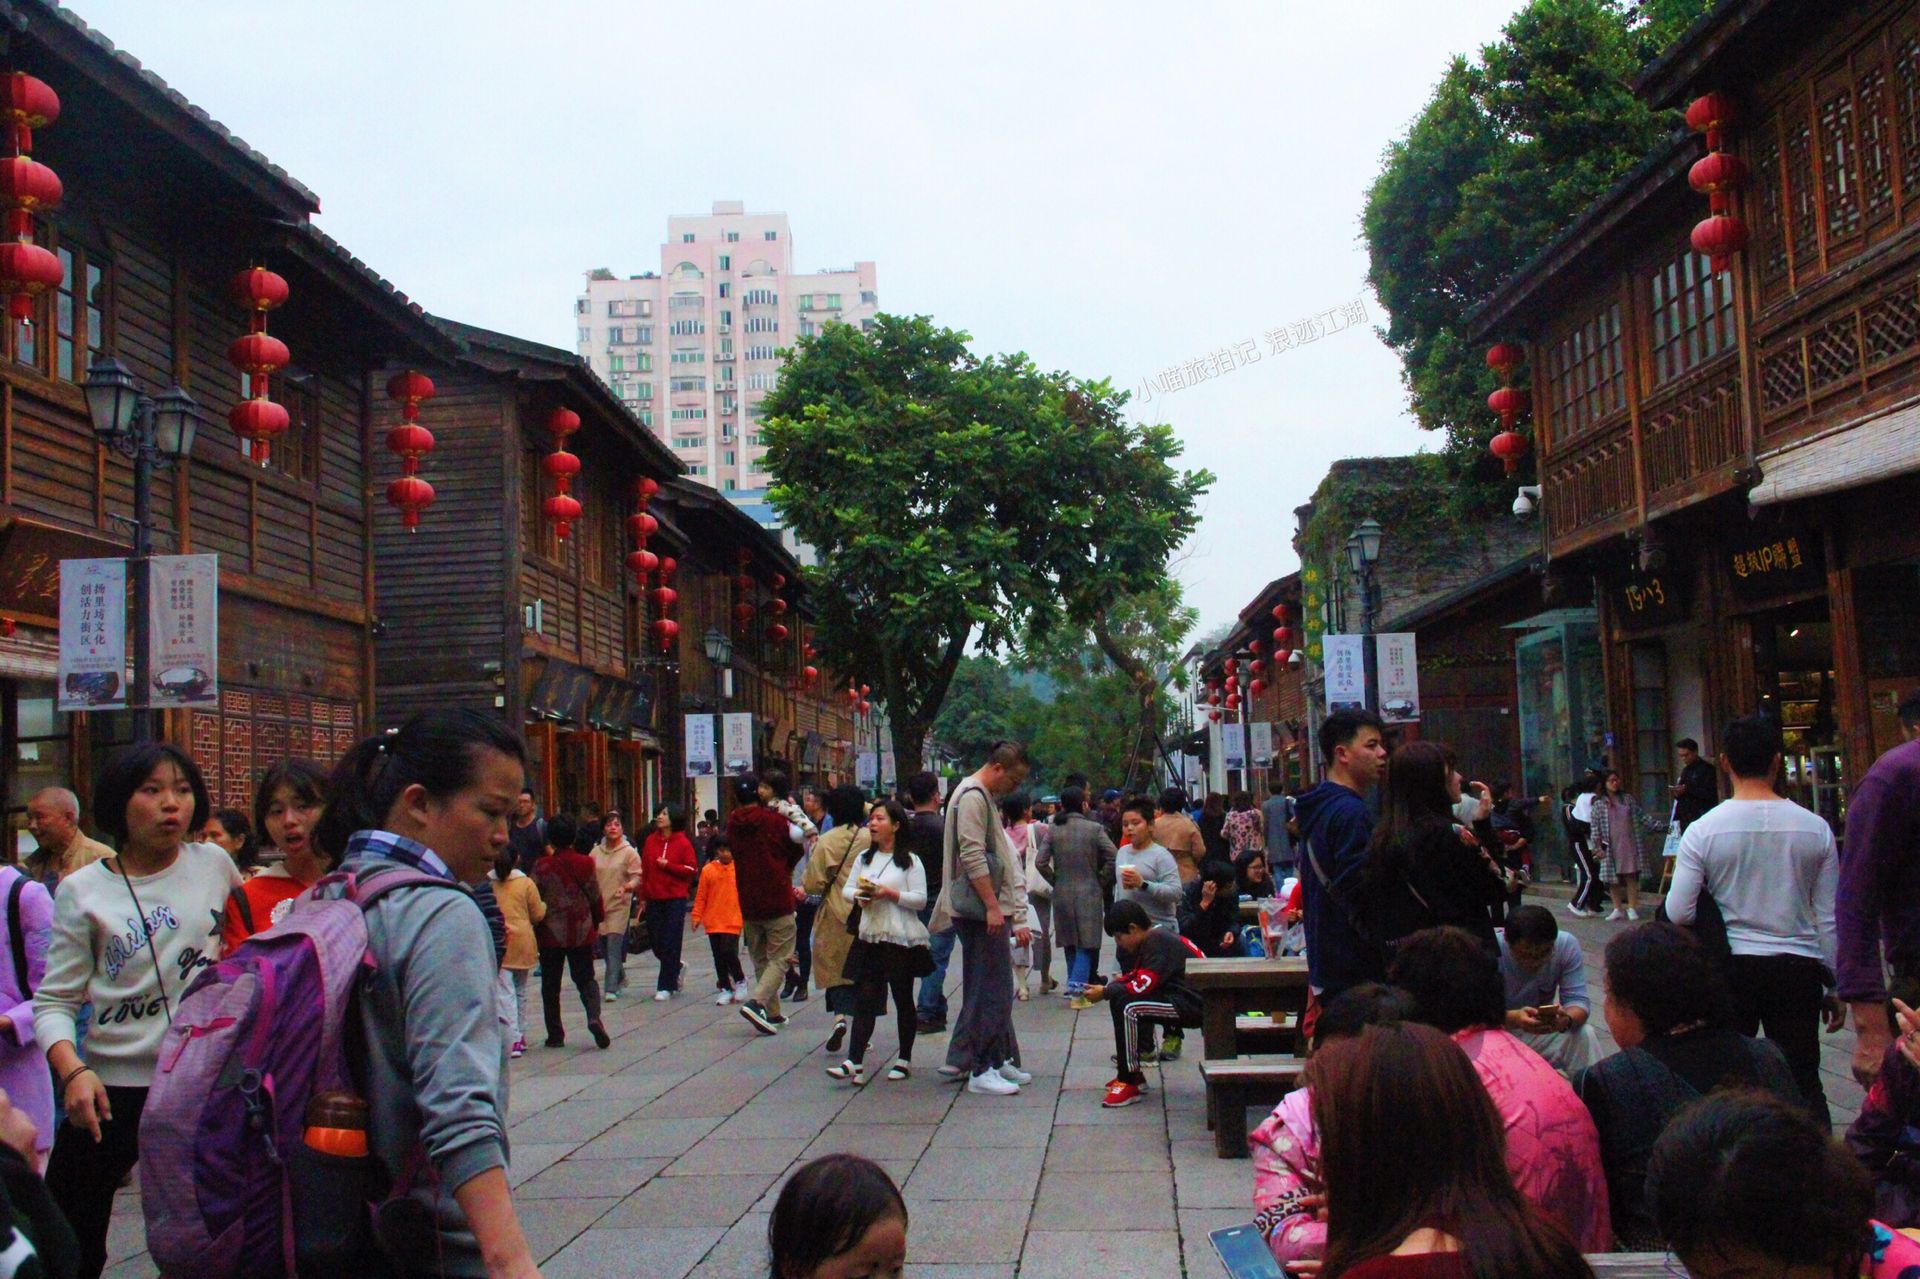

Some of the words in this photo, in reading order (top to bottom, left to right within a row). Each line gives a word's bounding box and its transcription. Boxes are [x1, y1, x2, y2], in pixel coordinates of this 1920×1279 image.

[80, 582, 92, 646] 创活力街区
